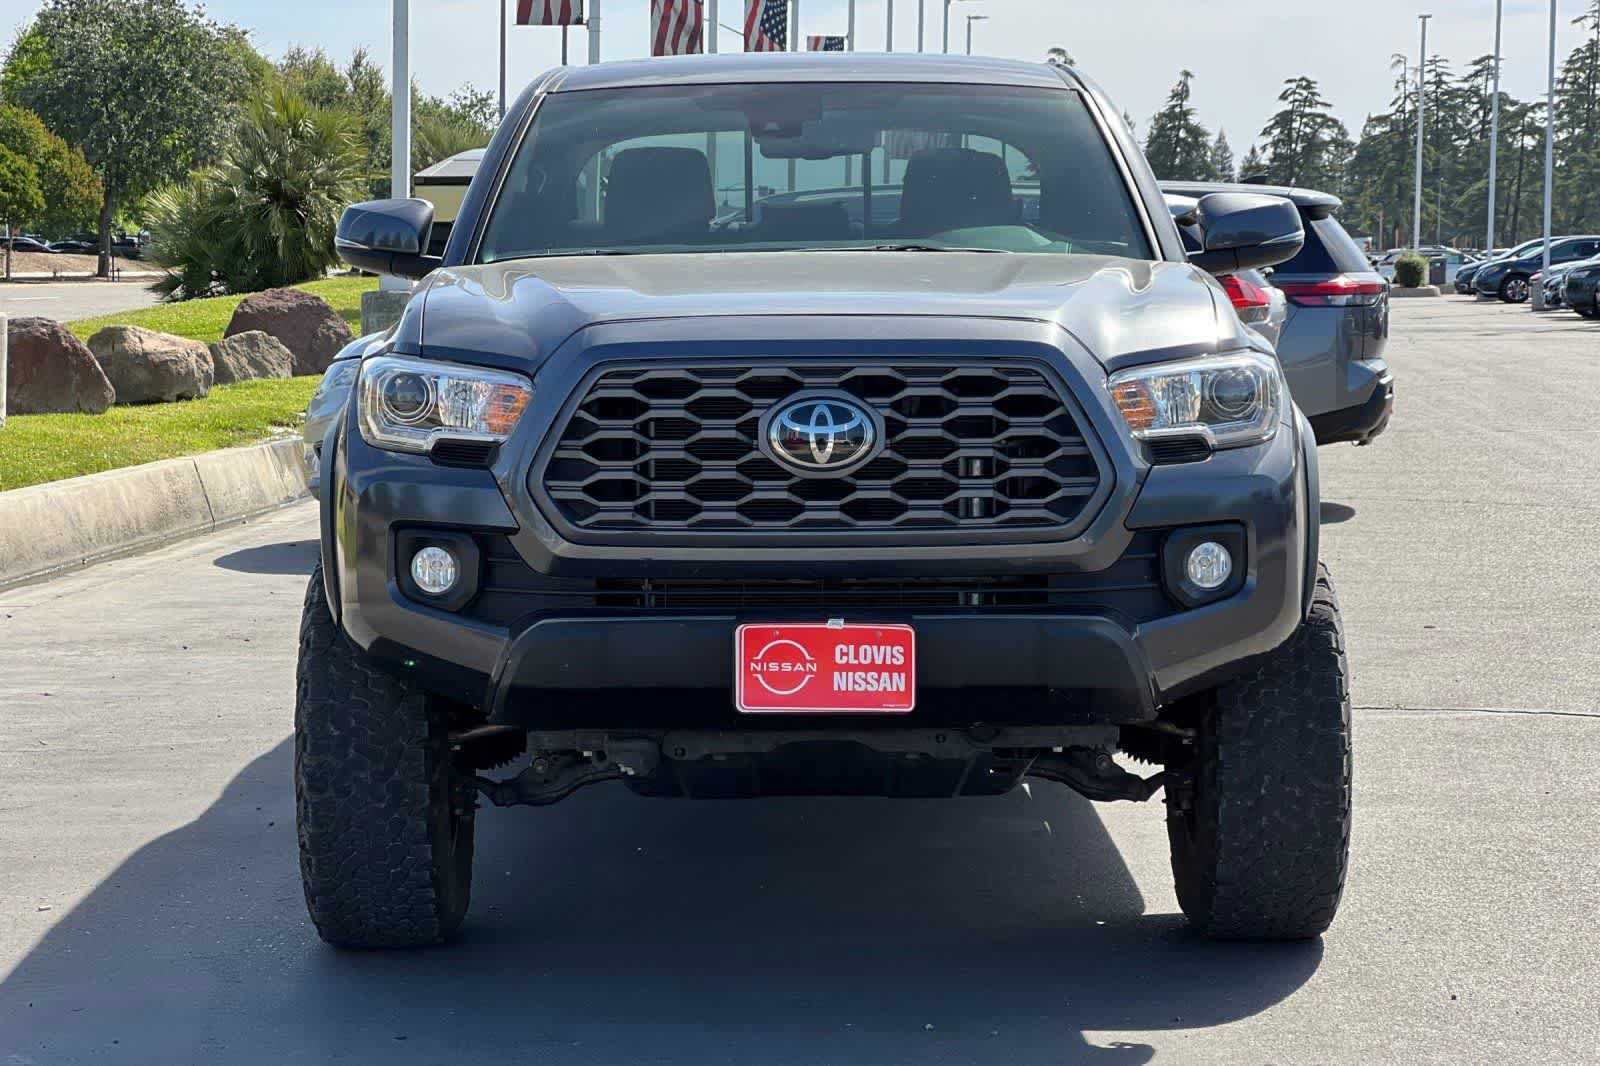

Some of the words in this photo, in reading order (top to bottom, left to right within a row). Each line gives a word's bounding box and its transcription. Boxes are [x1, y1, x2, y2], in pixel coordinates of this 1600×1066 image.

[835, 644, 905, 666] CLOVIS
[750, 662, 817, 672] NISSAN
[833, 671, 906, 692] NISSAN
